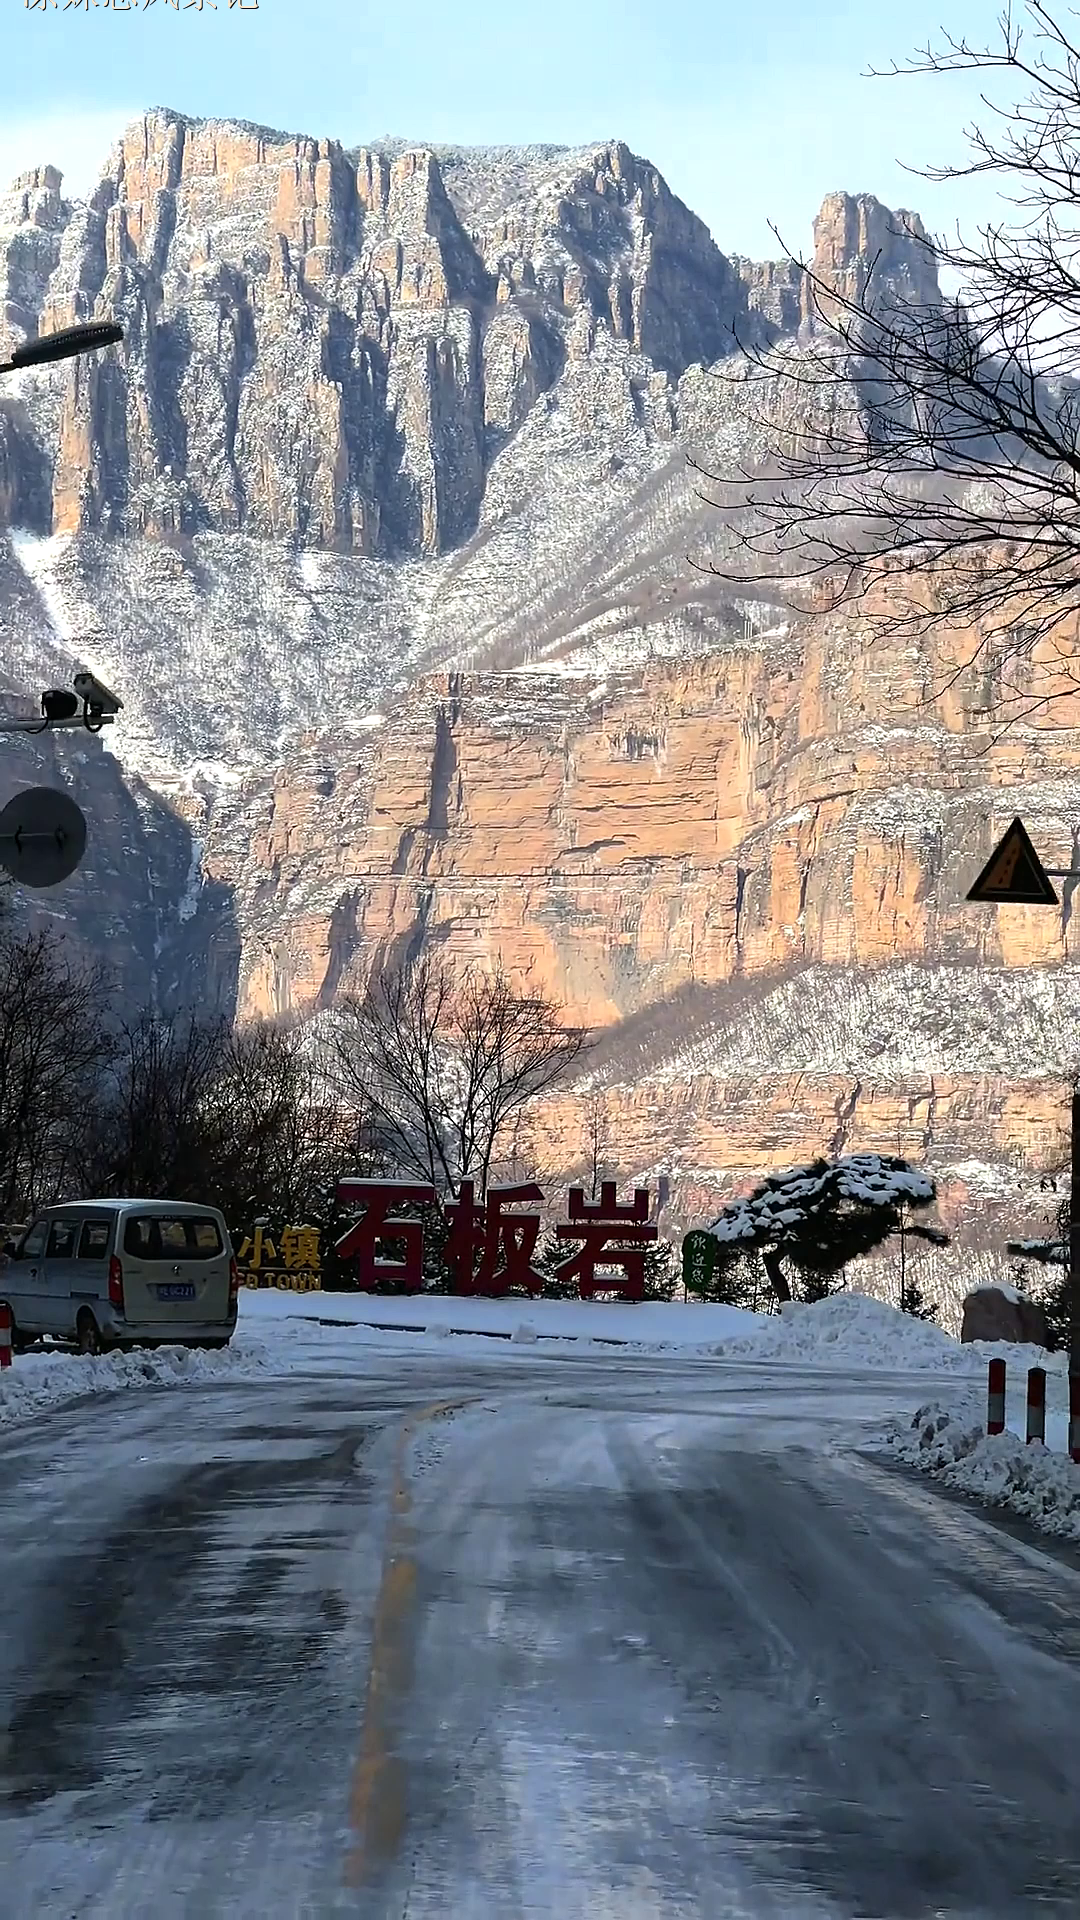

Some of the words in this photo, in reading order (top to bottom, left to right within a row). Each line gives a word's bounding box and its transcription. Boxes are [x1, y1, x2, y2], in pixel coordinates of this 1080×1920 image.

[237, 1224, 321, 1269] 小镇
[334, 1177, 658, 1300] 石板岩
